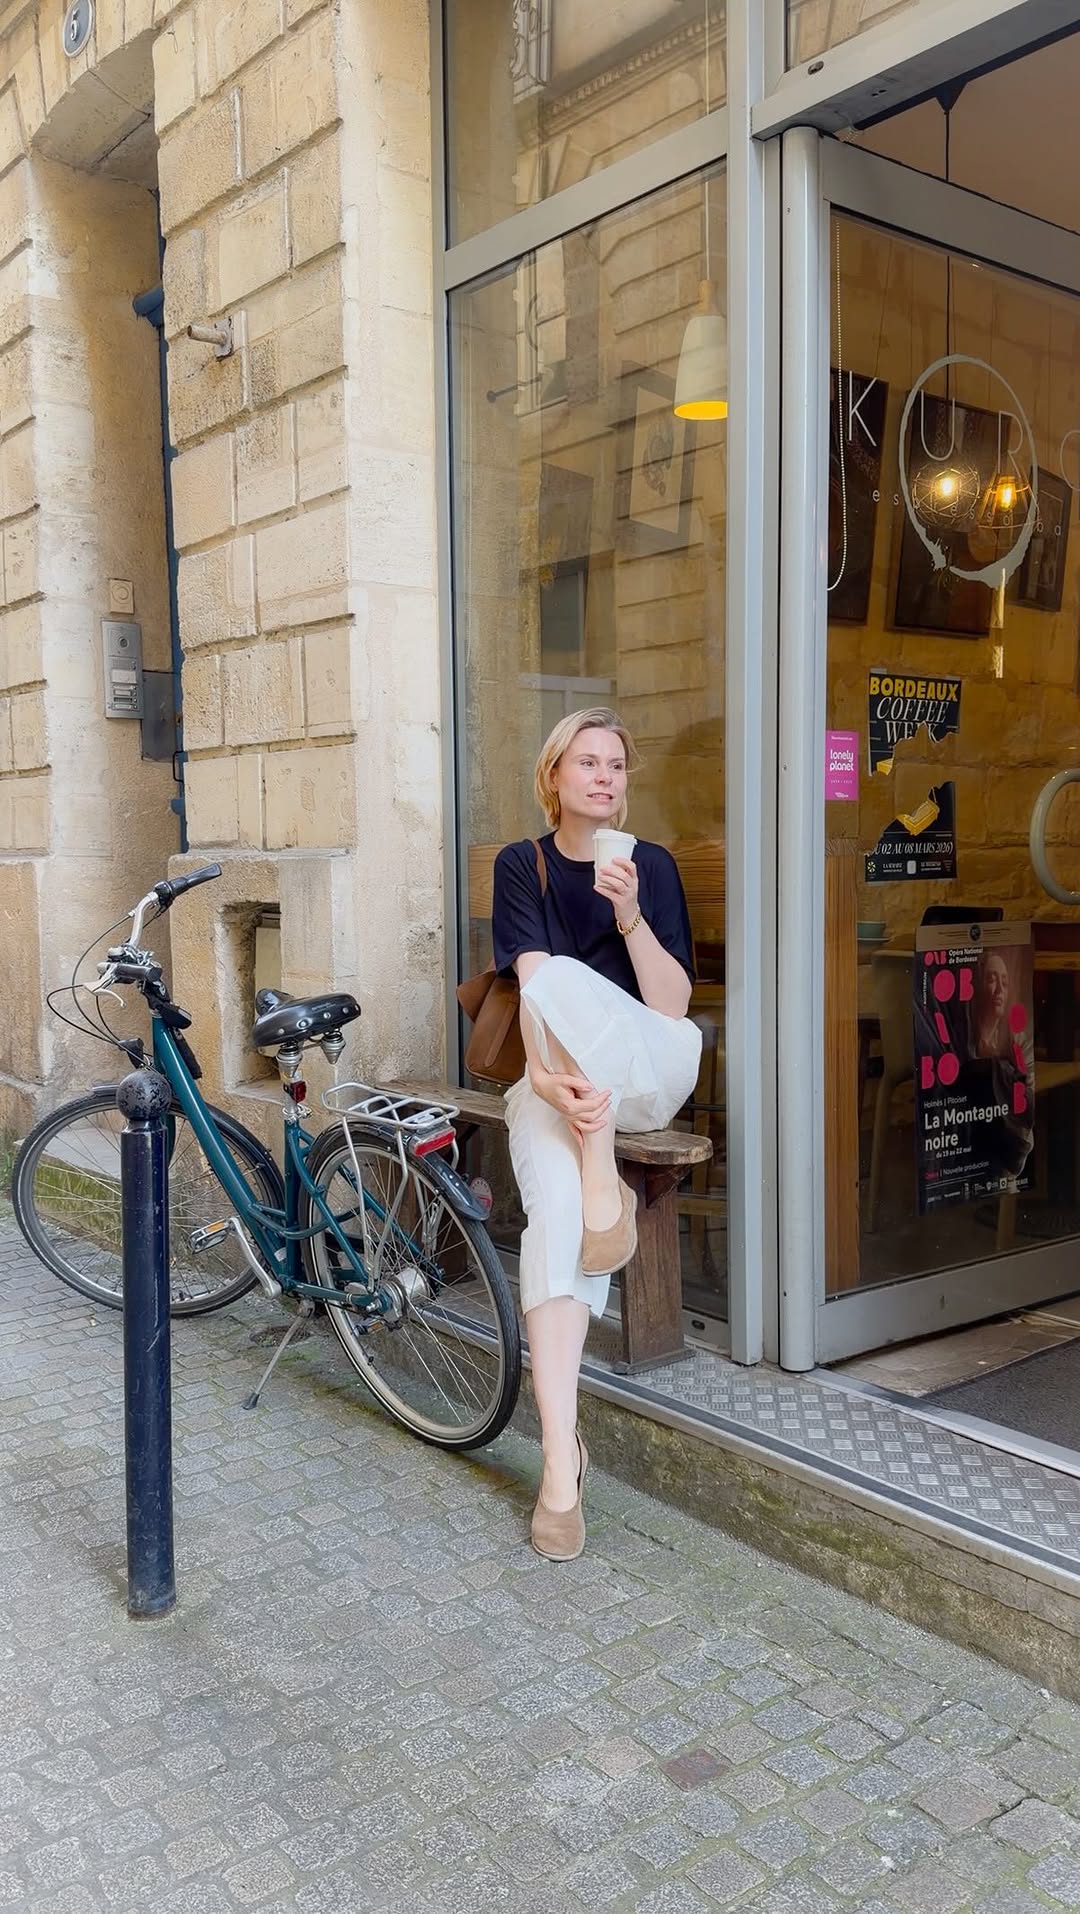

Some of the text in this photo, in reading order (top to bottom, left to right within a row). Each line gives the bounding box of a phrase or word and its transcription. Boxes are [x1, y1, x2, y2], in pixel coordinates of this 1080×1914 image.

[71, 7, 80, 41] 5
[872, 489, 1011, 527] espesso
[870, 677, 958, 702] BORDEAUX
[876, 697, 950, 723] COFFEE
[885, 720, 939, 743] WEK
[830, 749, 854, 763] lonely
[830, 760, 854, 772] planet
[881, 843, 892, 855] 02
[892, 843, 905, 855] AU
[905, 843, 915, 854] 08
[914, 842, 936, 854] MARS
[955, 956, 978, 964] Bordeaux
[925, 1103, 1009, 1130] La Montagne
[925, 1131, 959, 1152] noire
